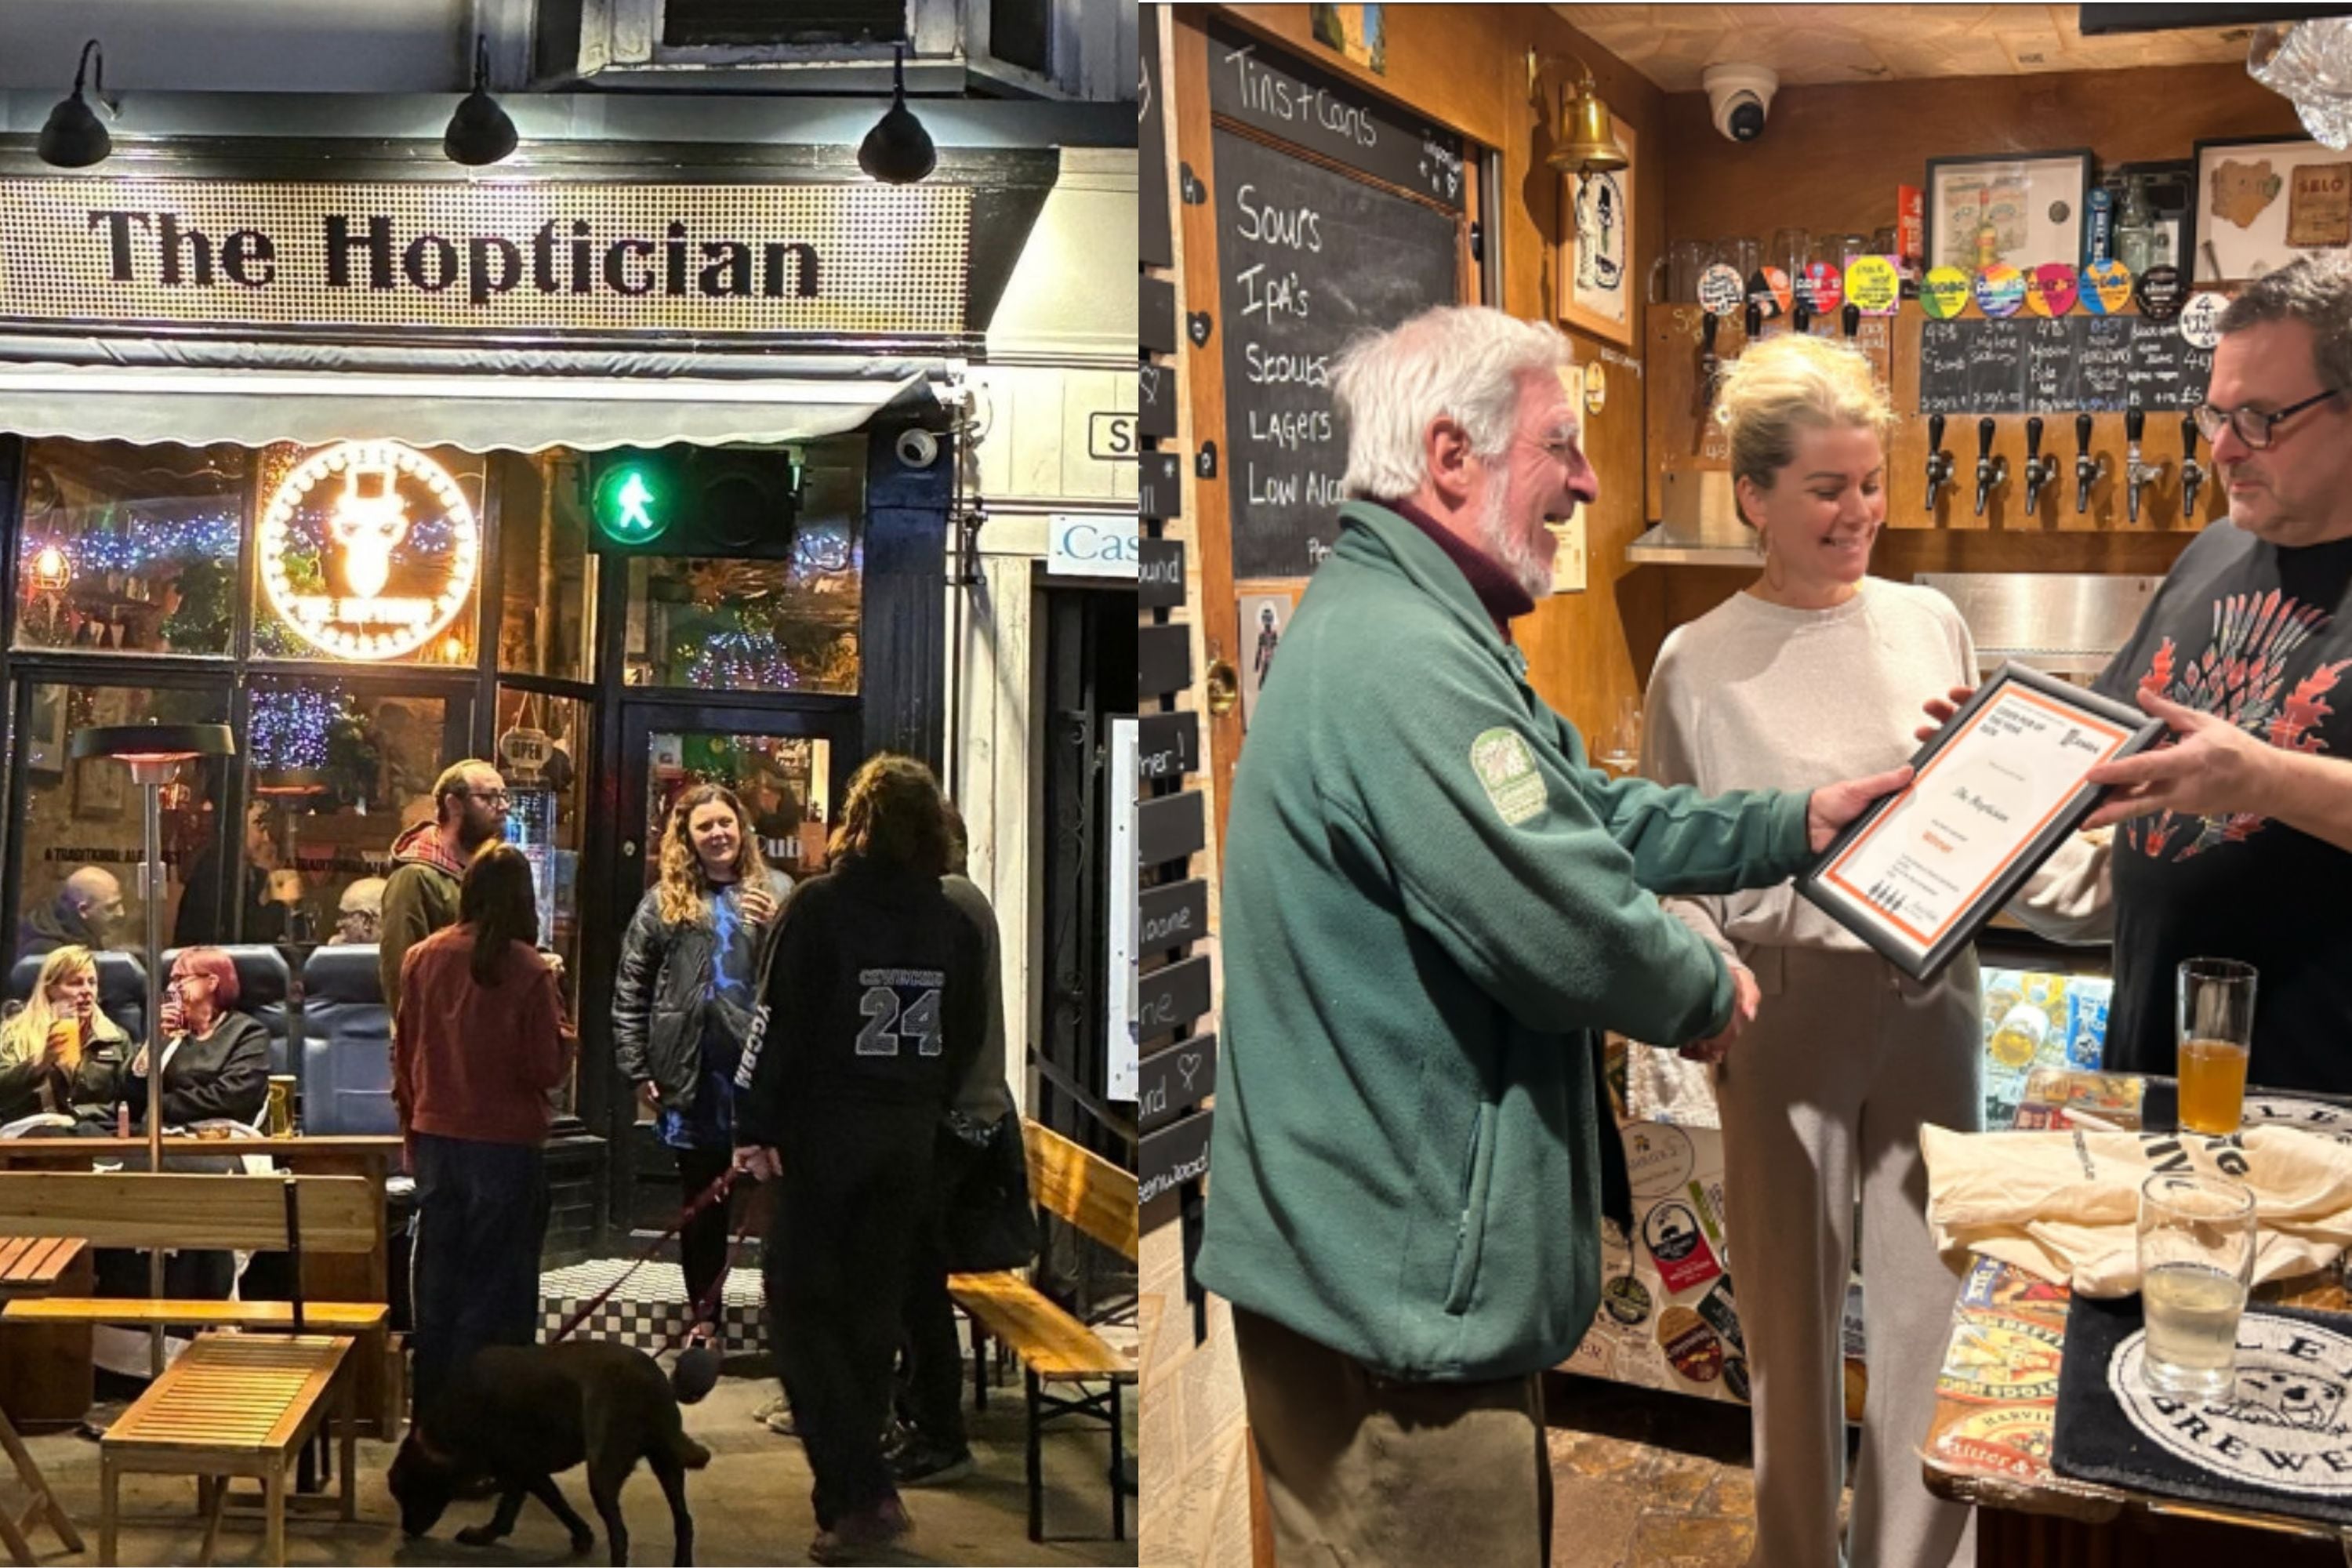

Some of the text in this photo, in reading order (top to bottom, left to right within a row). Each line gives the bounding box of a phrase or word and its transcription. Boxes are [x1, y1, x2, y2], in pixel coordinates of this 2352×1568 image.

[88, 209, 820, 306] The Hoptician
[855, 986, 942, 1055] 24
